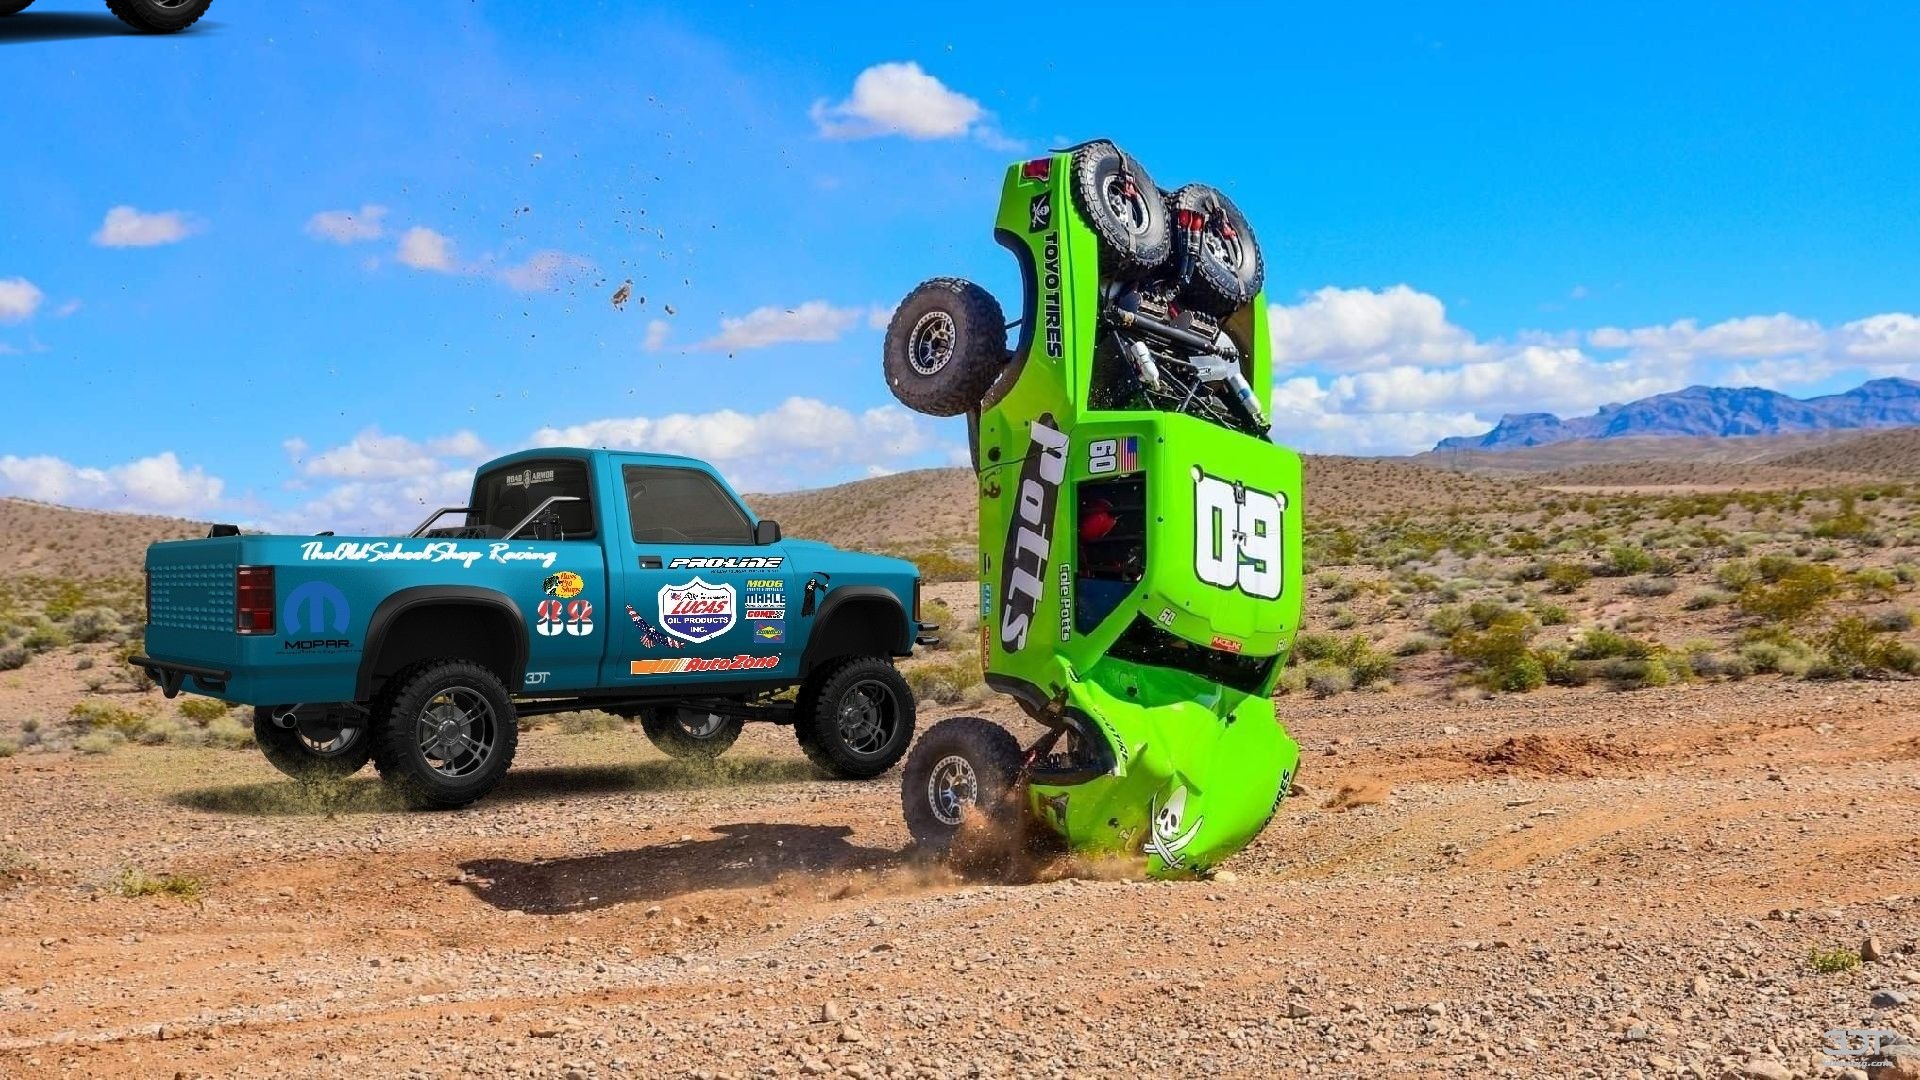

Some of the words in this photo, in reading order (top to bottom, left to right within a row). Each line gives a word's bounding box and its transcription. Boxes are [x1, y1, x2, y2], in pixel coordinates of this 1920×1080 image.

[532, 470, 554, 480] ARMOR
[489, 543, 557, 568] Racing
[747, 579, 784, 588] MOOG
[1059, 563, 1070, 598] Cole
[745, 594, 786, 603] MAHLE
[671, 601, 728, 615] LUCAS
[536, 600, 594, 636] 88
[667, 617, 681, 625] OIL
[1061, 598, 1071, 641] Potts
[284, 640, 350, 650] MOPAR
[685, 654, 780, 672] AutoZone
